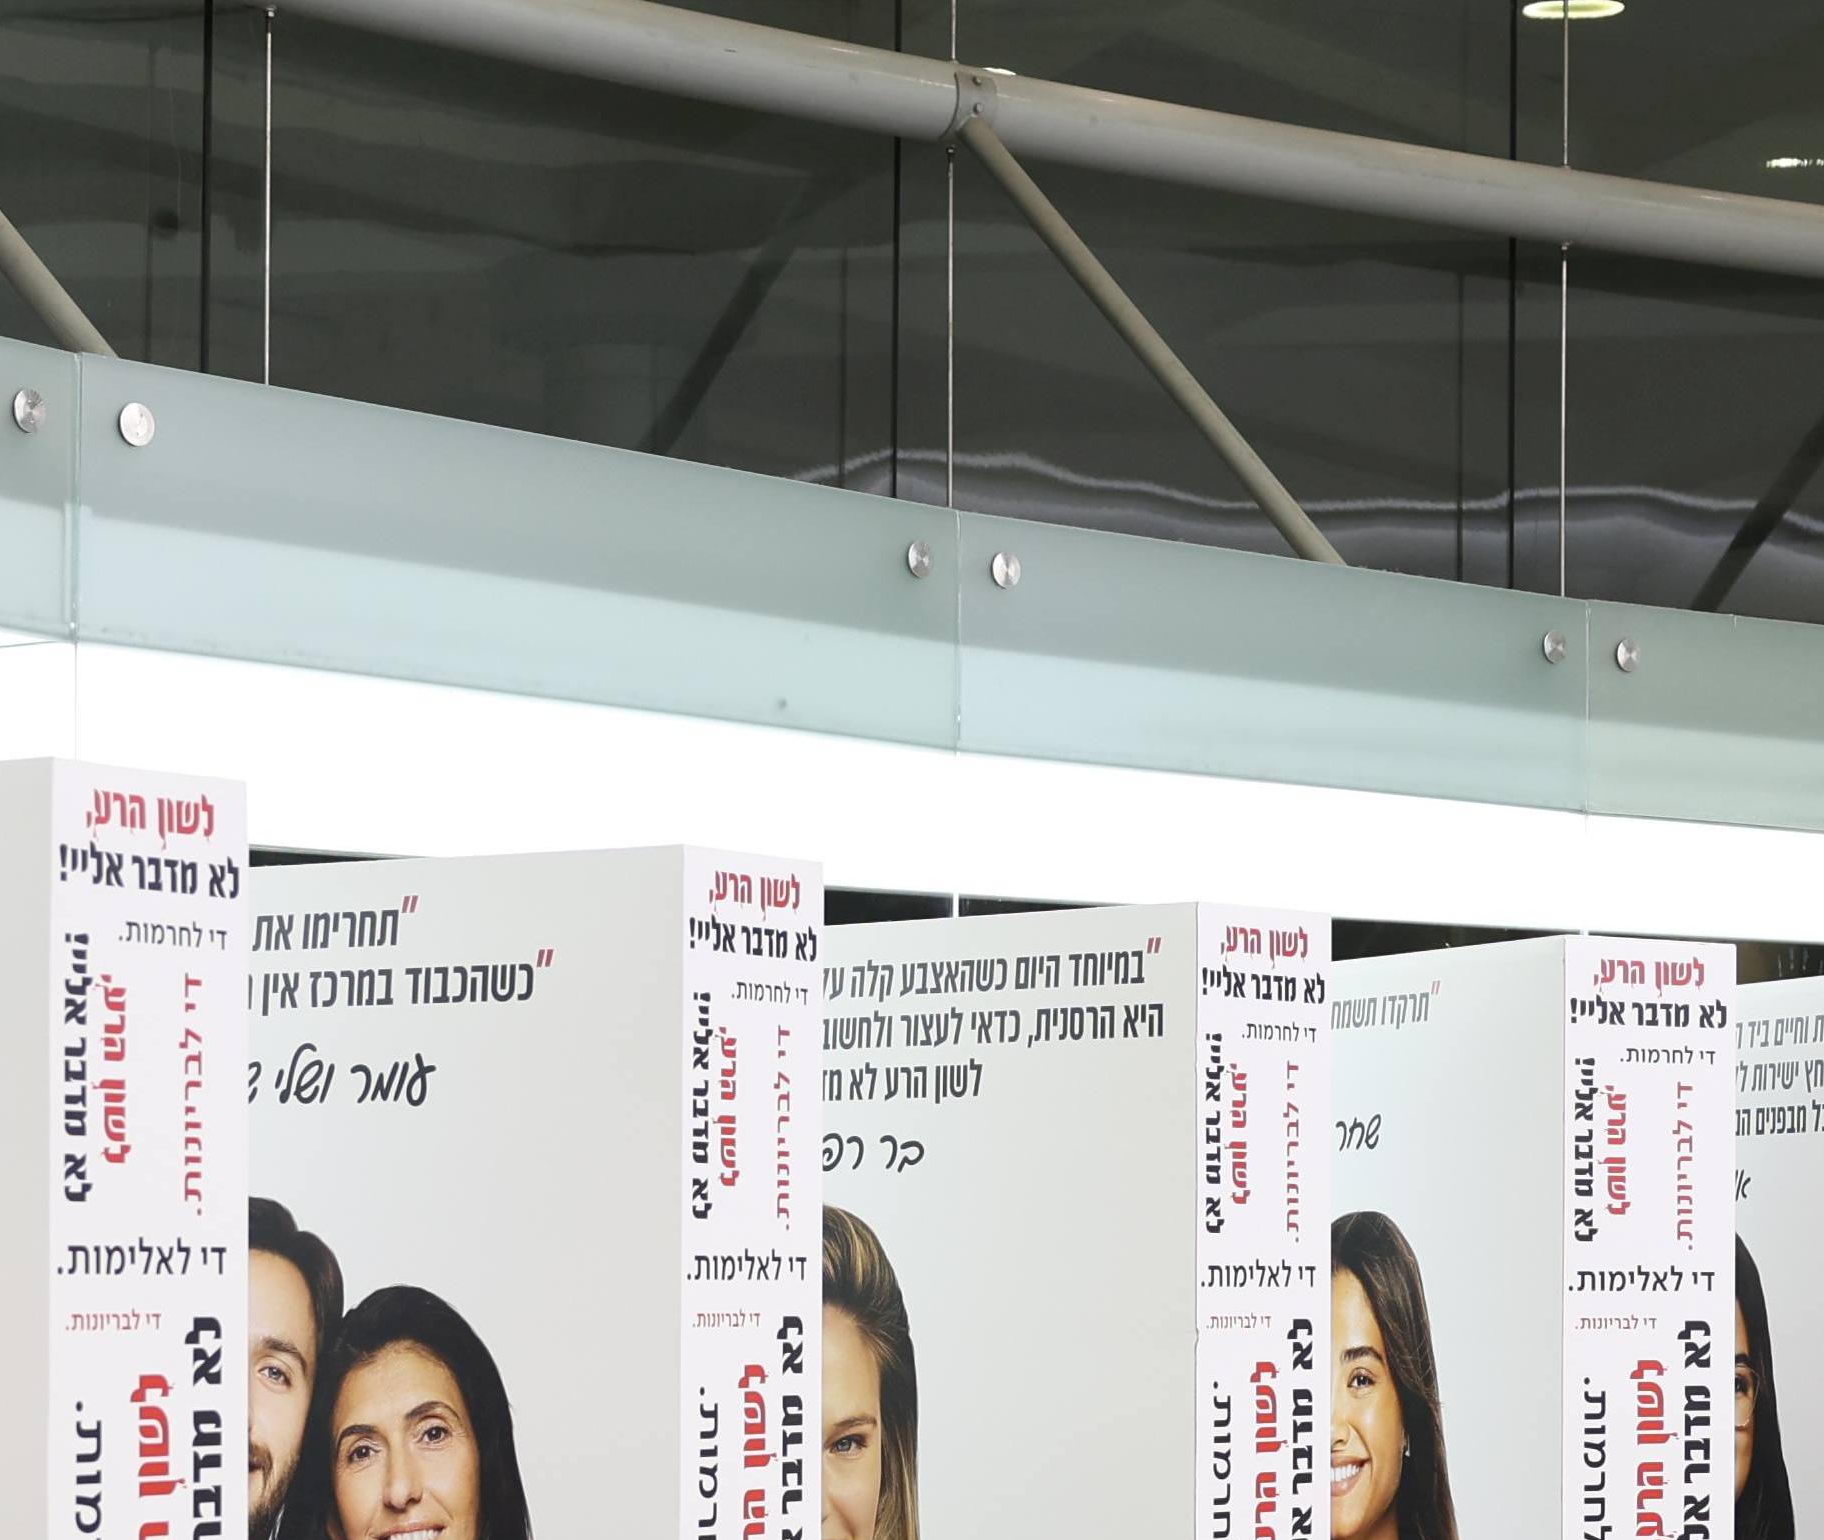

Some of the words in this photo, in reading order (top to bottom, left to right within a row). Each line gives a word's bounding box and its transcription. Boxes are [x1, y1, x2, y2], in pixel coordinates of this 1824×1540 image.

[209, 929, 228, 951] די
[251, 914, 294, 952] את
[741, 925, 788, 959] מדבר
[795, 928, 817, 962] לא
[309, 968, 394, 1008] במרכז
[850, 961, 895, 1003] קלה
[899, 957, 1008, 998] כשהאצבע
[1014, 954, 1061, 990] היום
[261, 972, 300, 1017] אין
[900, 1006, 964, 1048] לעצור
[970, 1009, 1021, 1044] כדאי
[1122, 1003, 1164, 1039] היא
[274, 1042, 335, 1105] ושלי
[350, 1052, 437, 1107] עומר
[1691, 1271, 1715, 1292] די
